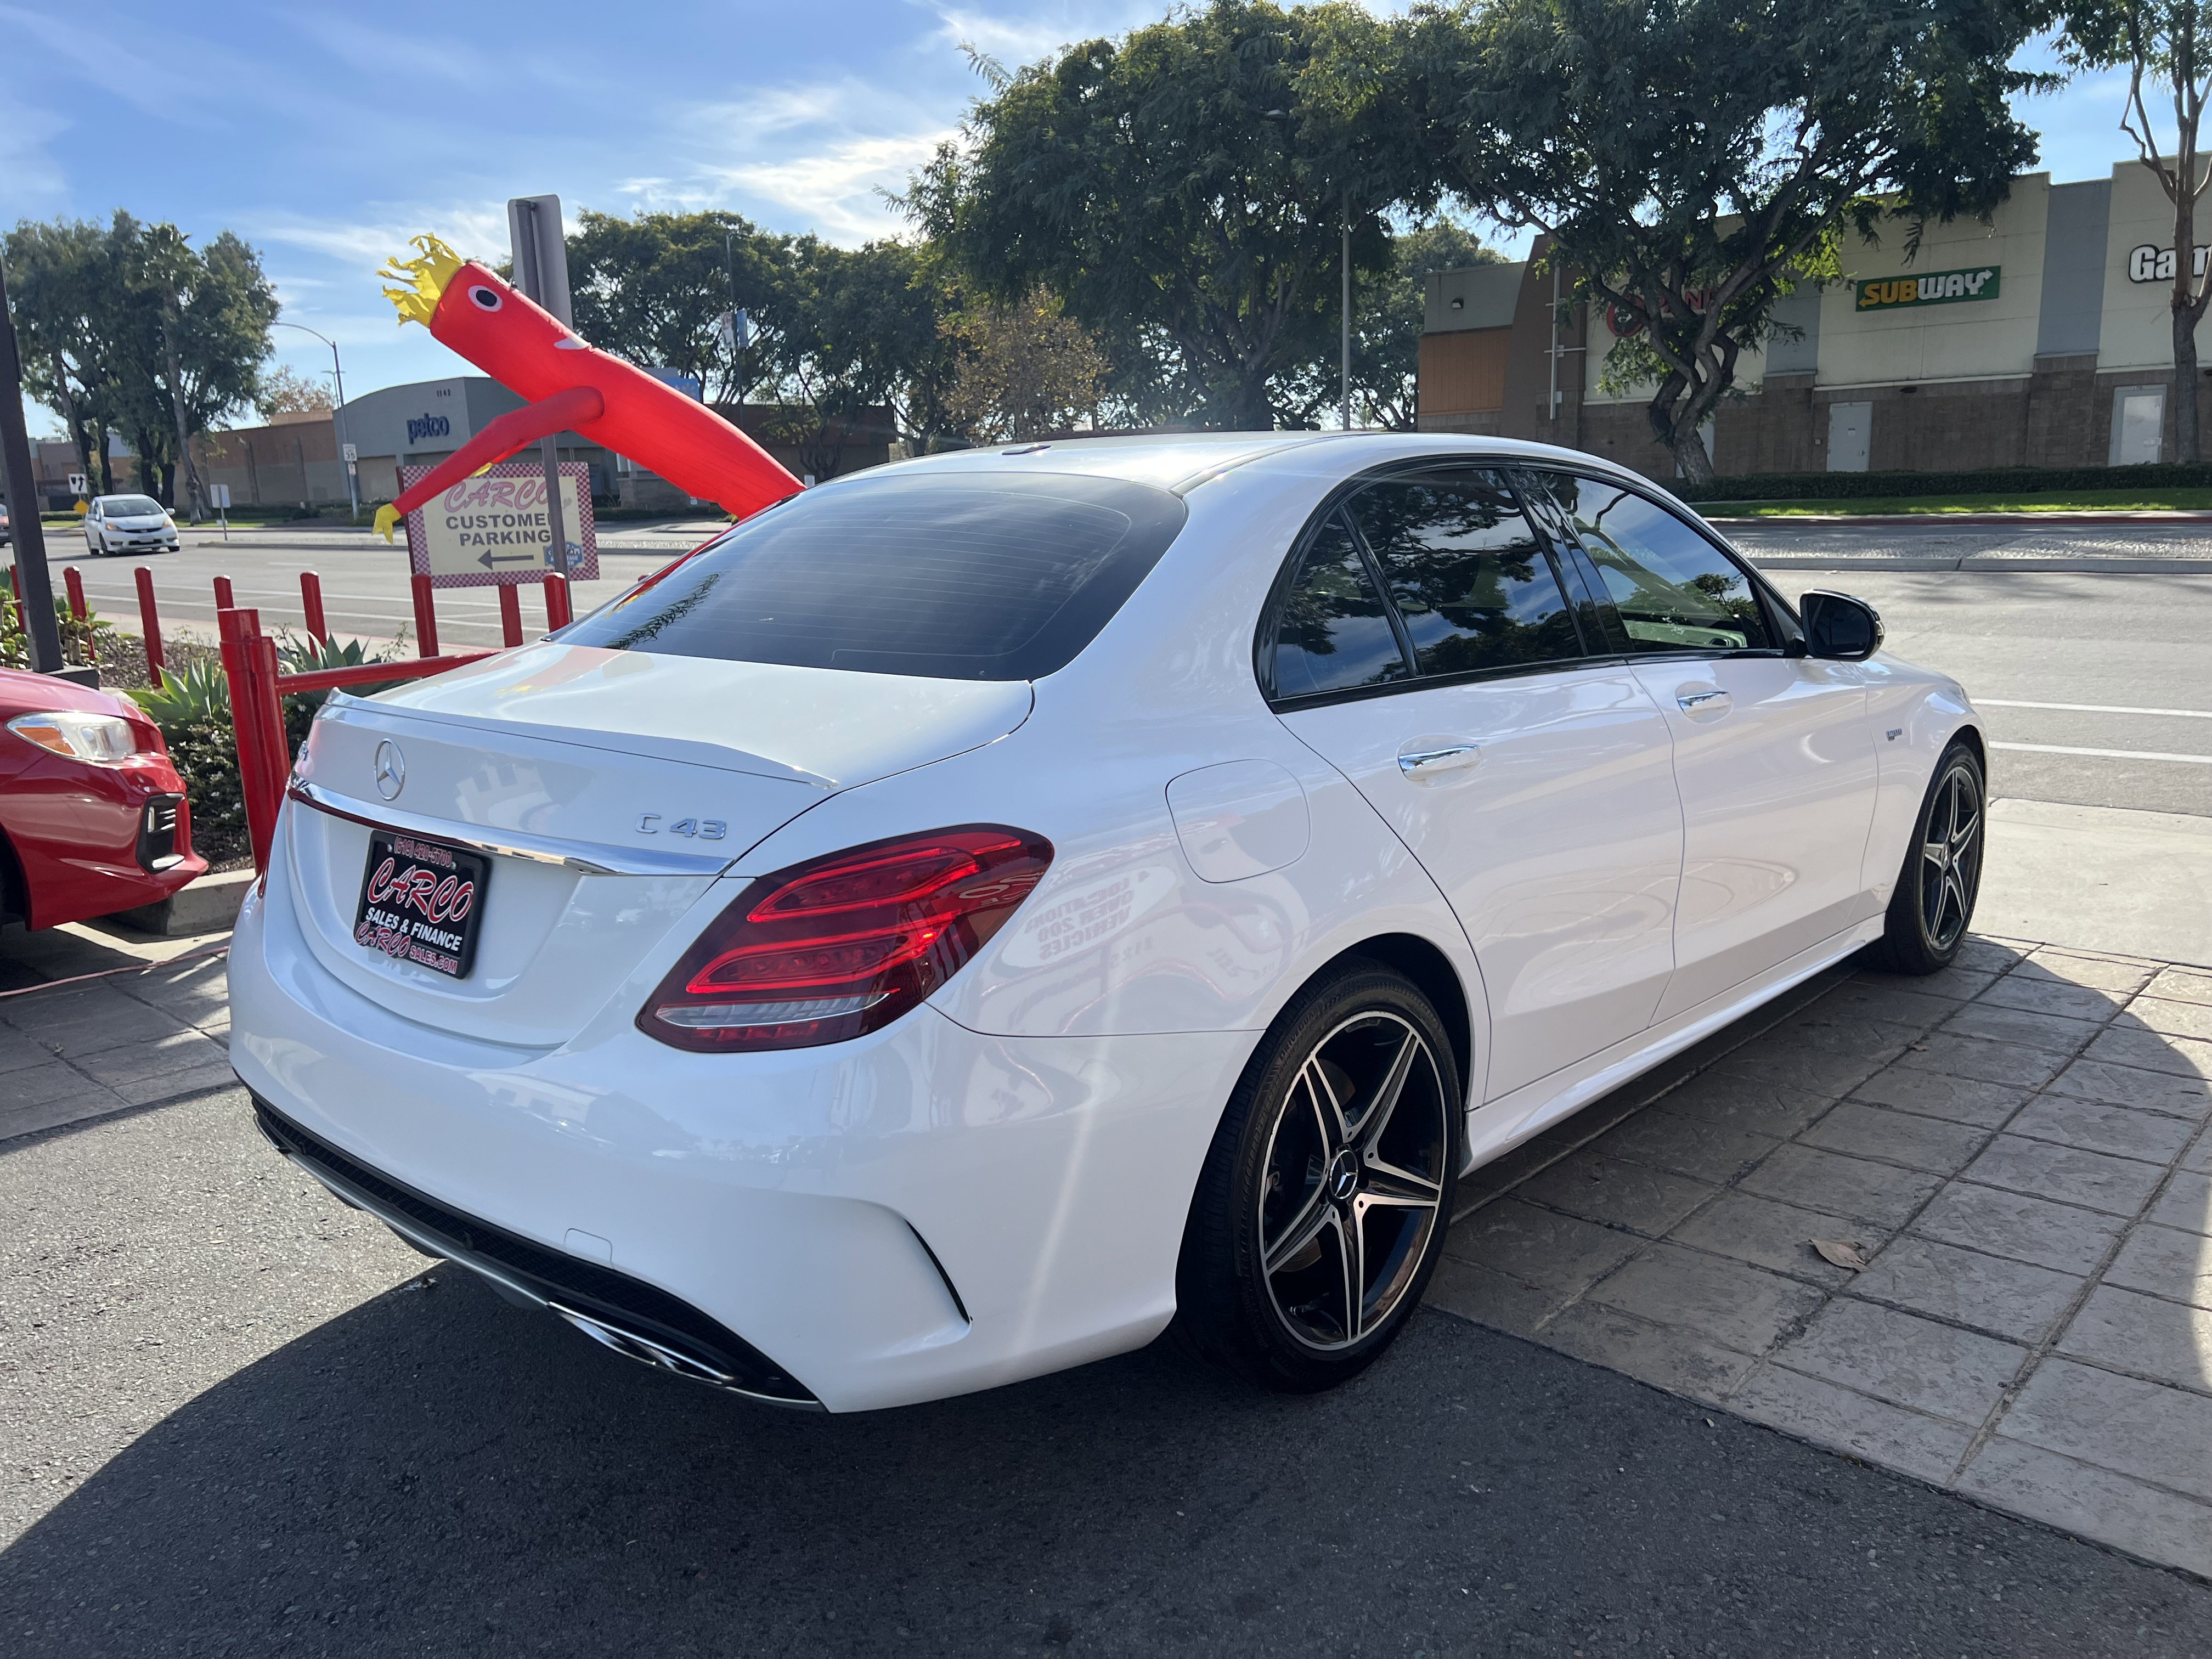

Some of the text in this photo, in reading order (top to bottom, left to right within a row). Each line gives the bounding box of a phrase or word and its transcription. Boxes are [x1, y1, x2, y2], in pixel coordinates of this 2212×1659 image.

[1859, 269, 1993, 308] SUBWAY
[436, 388, 450, 397] 1142
[407, 413, 450, 445] petco
[446, 513, 551, 529] CUSTOME
[459, 529, 551, 546] PARKING
[636, 813, 727, 840] C 43
[367, 857, 474, 924] CARCO
[365, 907, 463, 952] SALES & FINANCE
[355, 921, 458, 975] CARCO SALES.COM
[1278, 1002, 1323, 1060] DRIVEGUA
